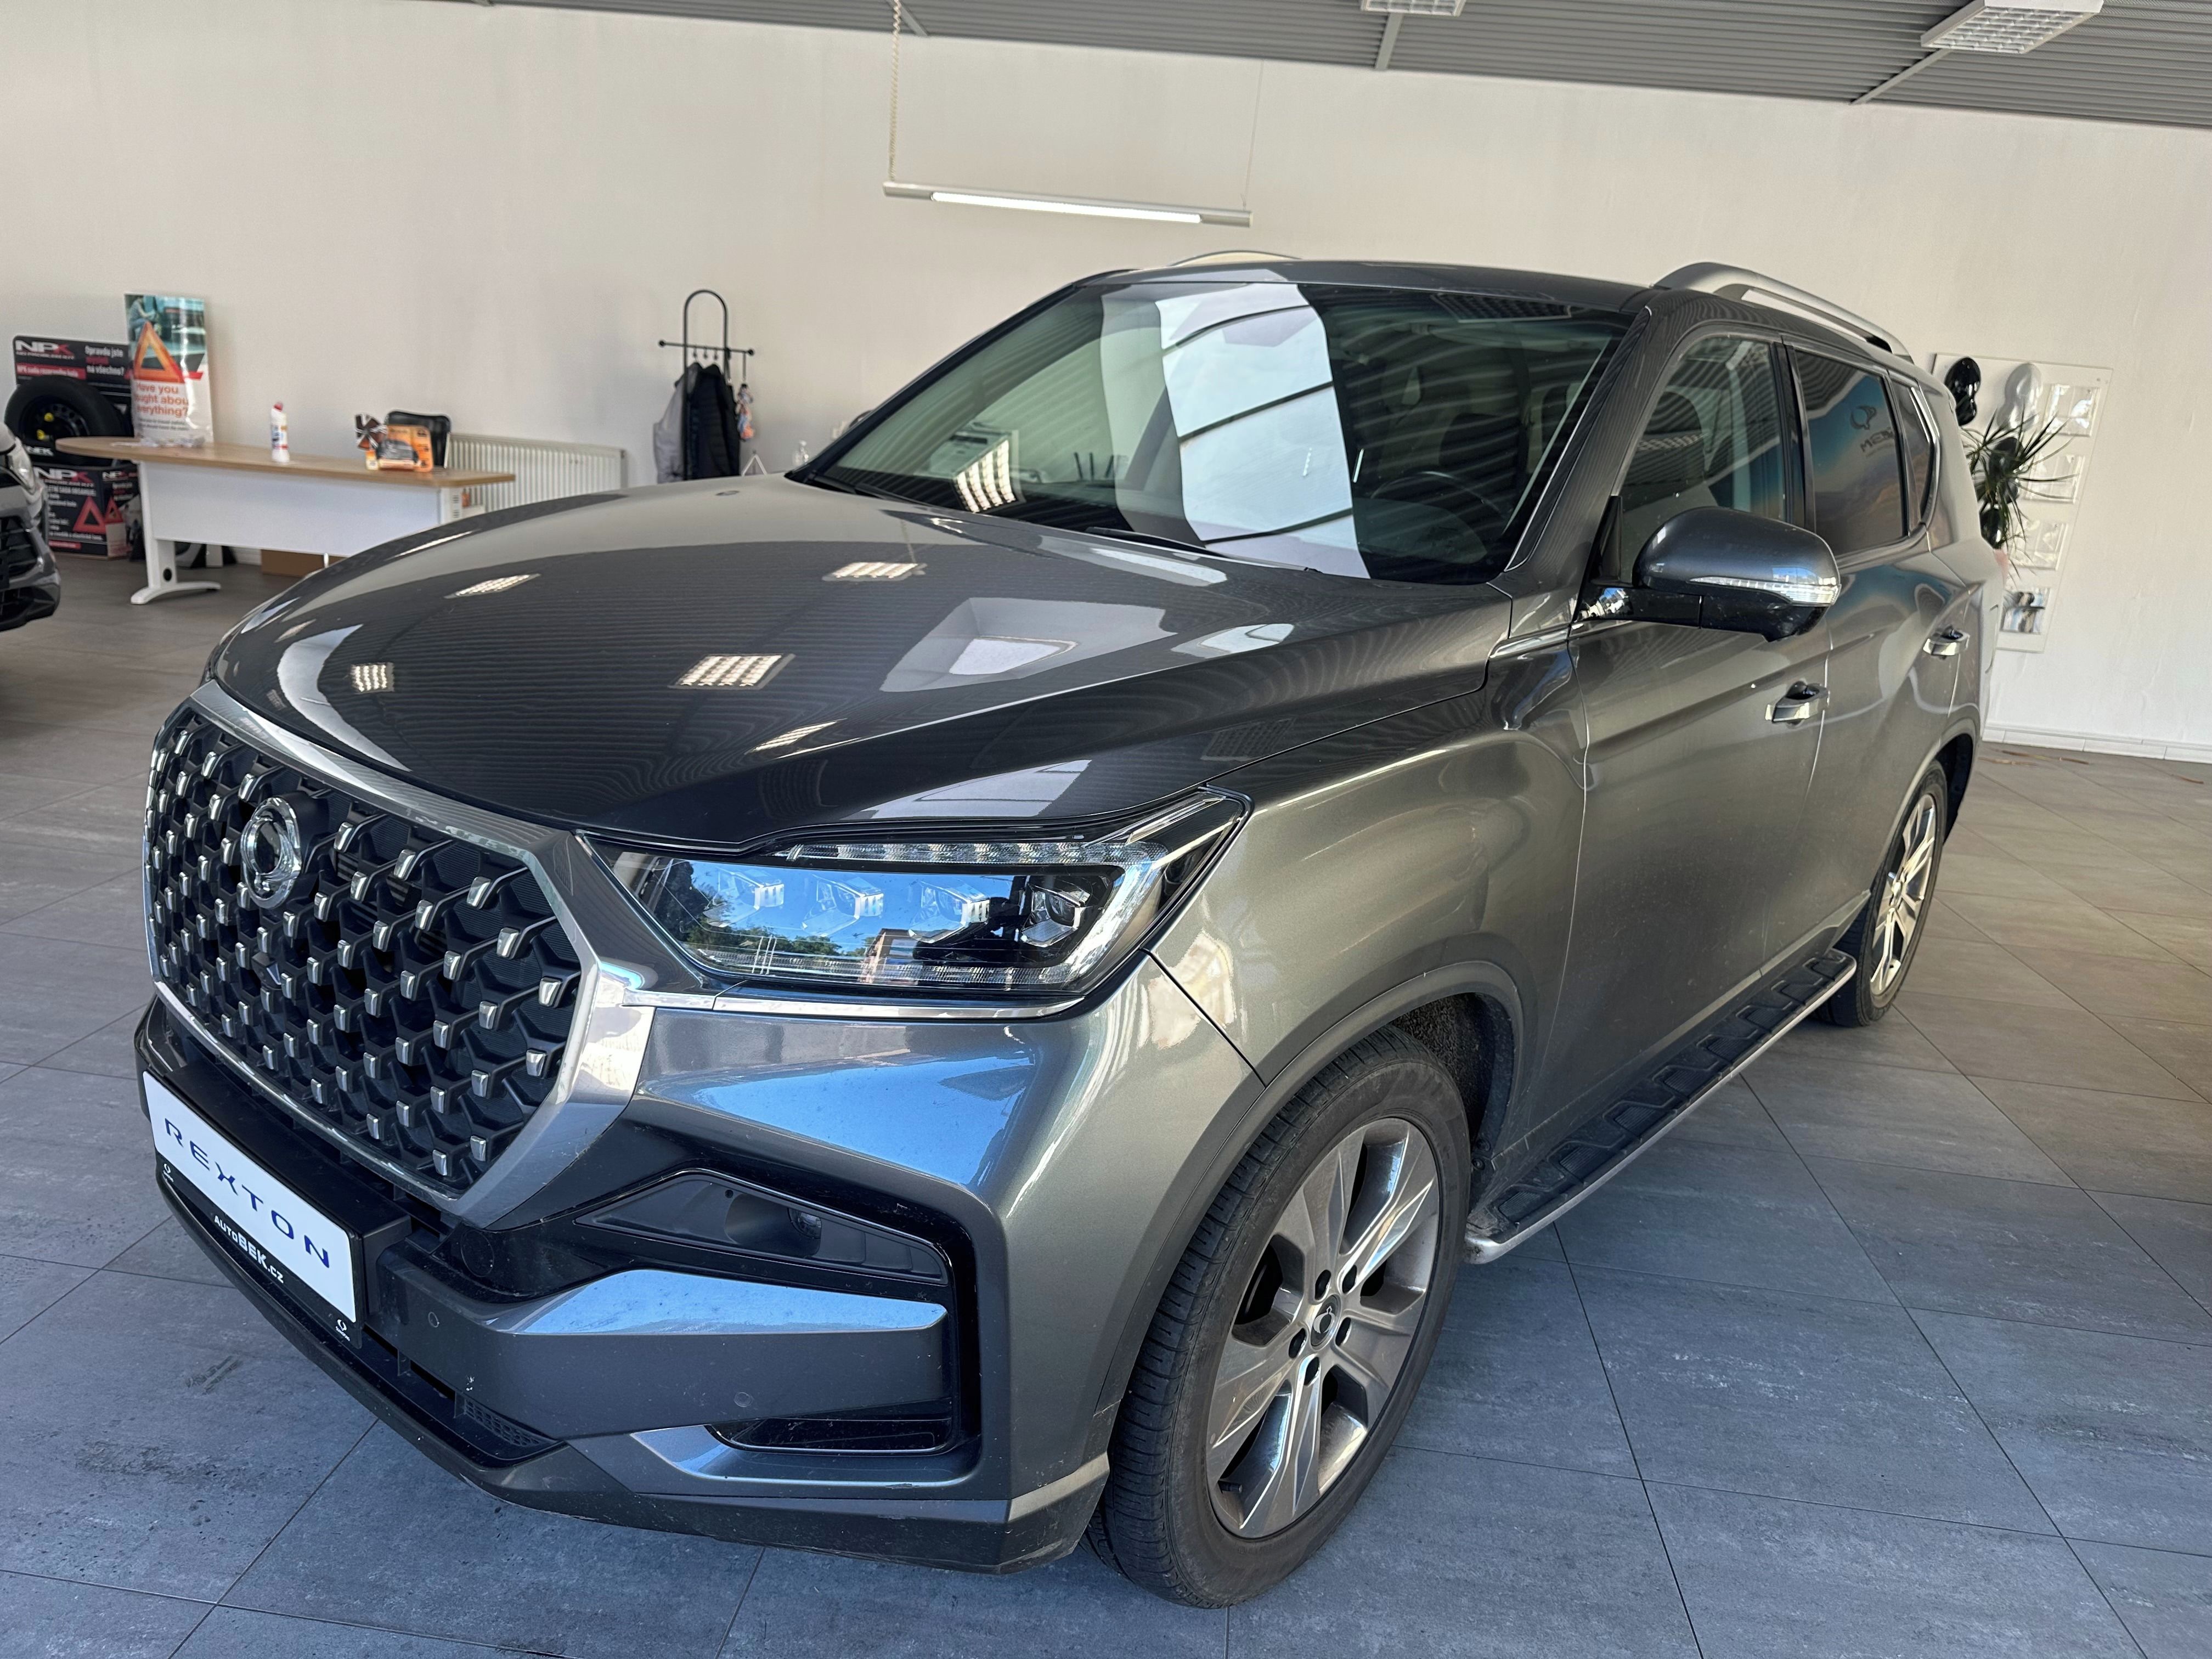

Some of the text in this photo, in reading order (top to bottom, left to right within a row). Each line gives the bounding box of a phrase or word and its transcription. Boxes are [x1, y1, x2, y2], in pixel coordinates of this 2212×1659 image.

[158, 385, 178, 395] you
[161, 394, 189, 406] abou
[165, 1118, 330, 1268] REXTON
